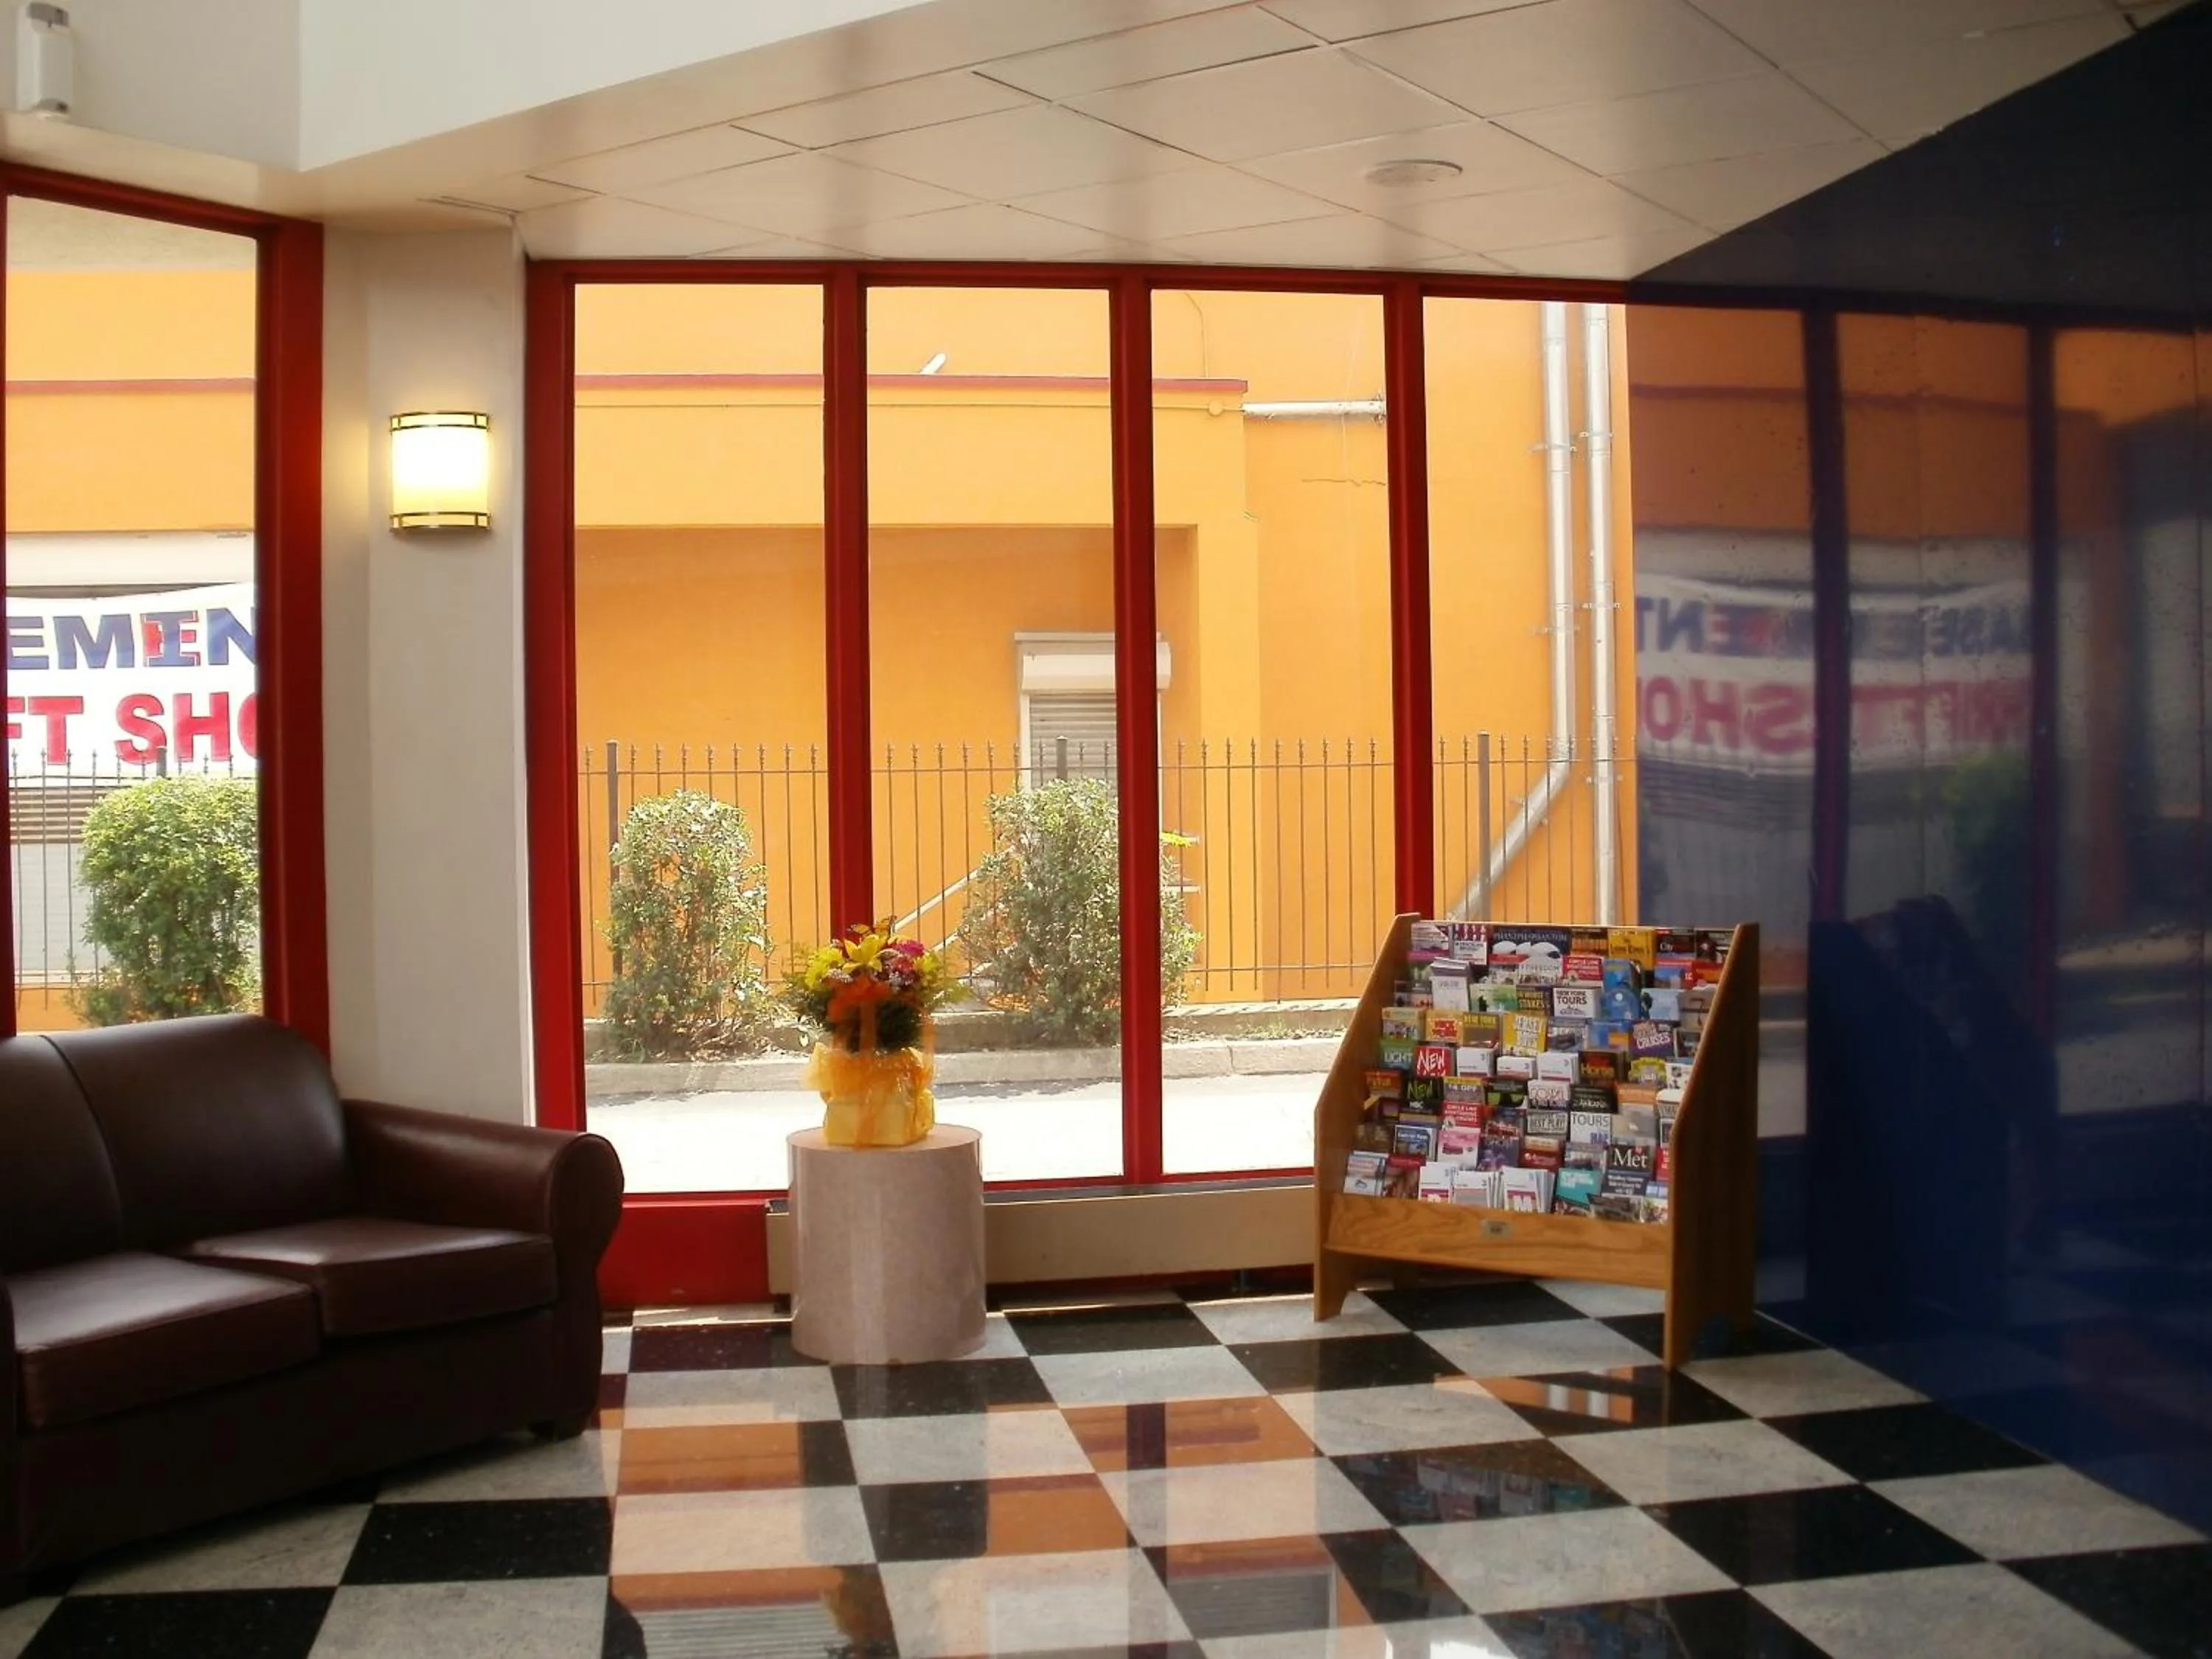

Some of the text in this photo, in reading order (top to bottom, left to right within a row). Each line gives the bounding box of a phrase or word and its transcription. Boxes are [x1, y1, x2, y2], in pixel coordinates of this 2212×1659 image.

[1557, 996, 1587, 1005] TOURS
[1416, 1048, 1445, 1071] NEW
[1571, 1113, 1610, 1128] TOURS
[1613, 1147, 1648, 1169] Met
